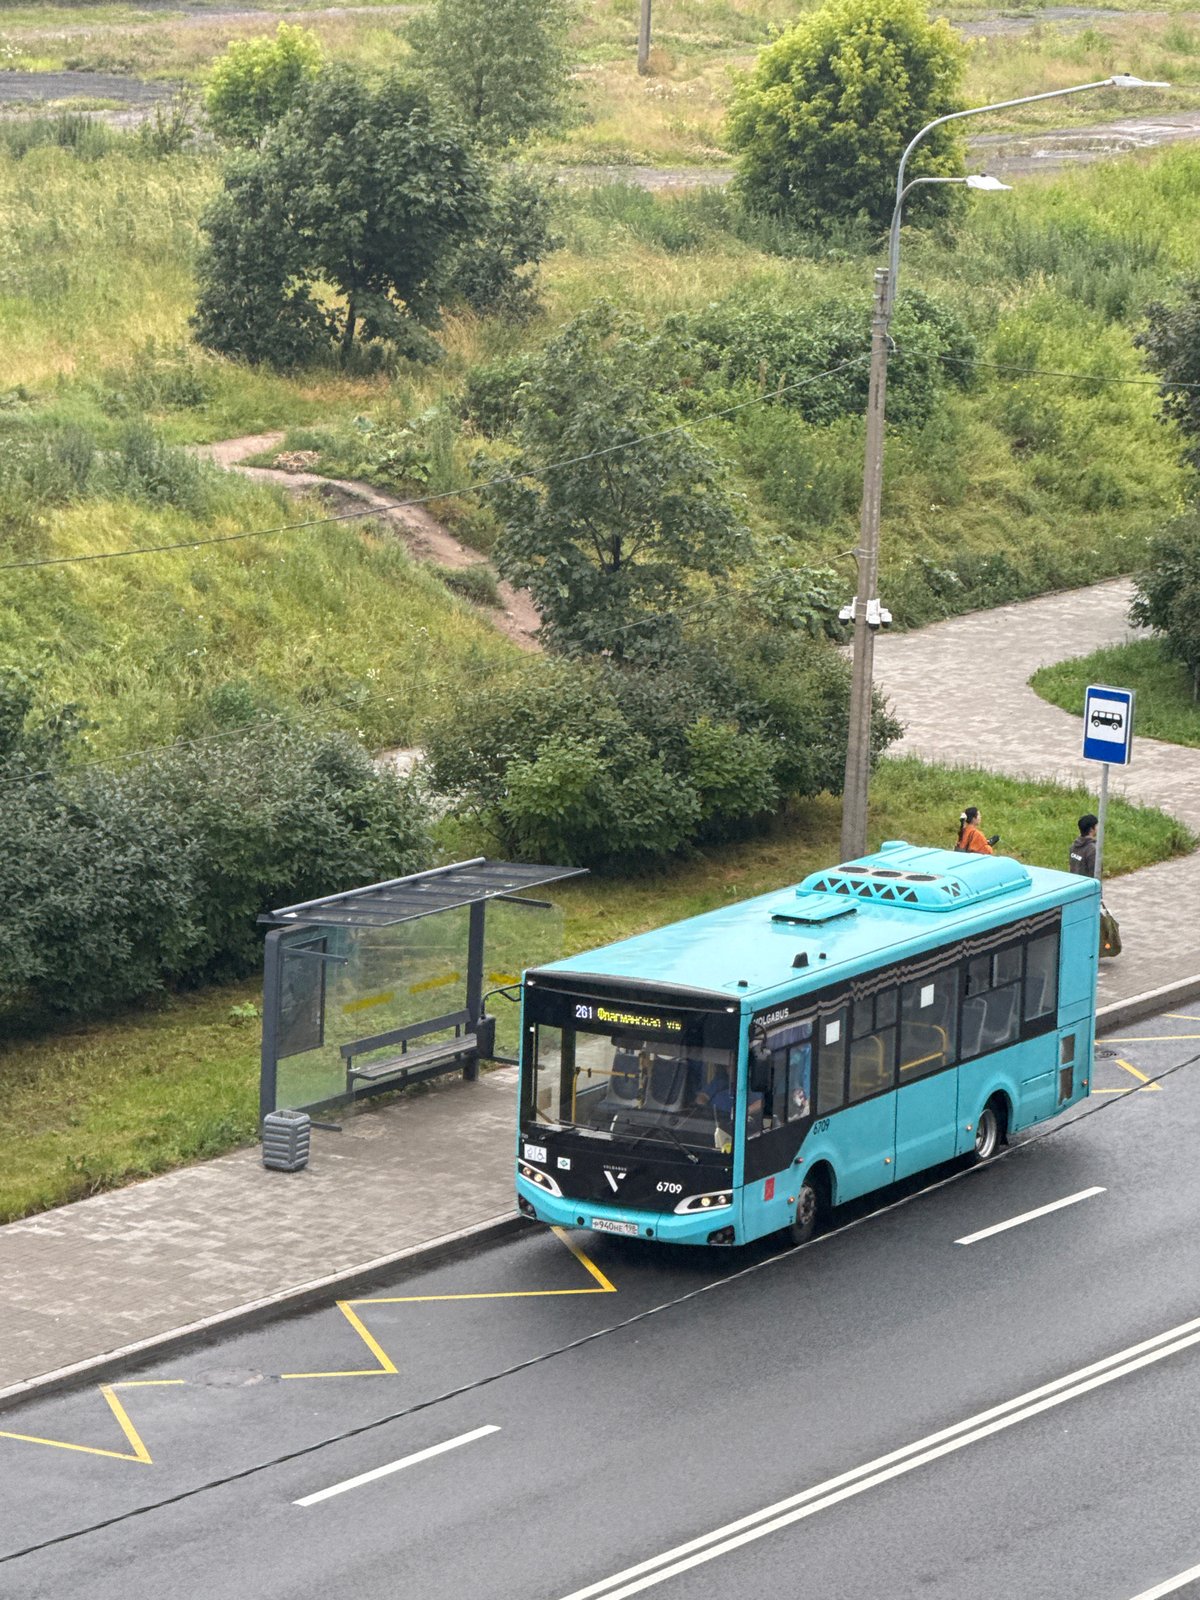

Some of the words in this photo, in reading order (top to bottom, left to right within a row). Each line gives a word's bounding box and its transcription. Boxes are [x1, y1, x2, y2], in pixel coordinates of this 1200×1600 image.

[575, 1004, 592, 1019] 261
[812, 1118, 831, 1136] 6709
[656, 1181, 682, 1194] 6709
